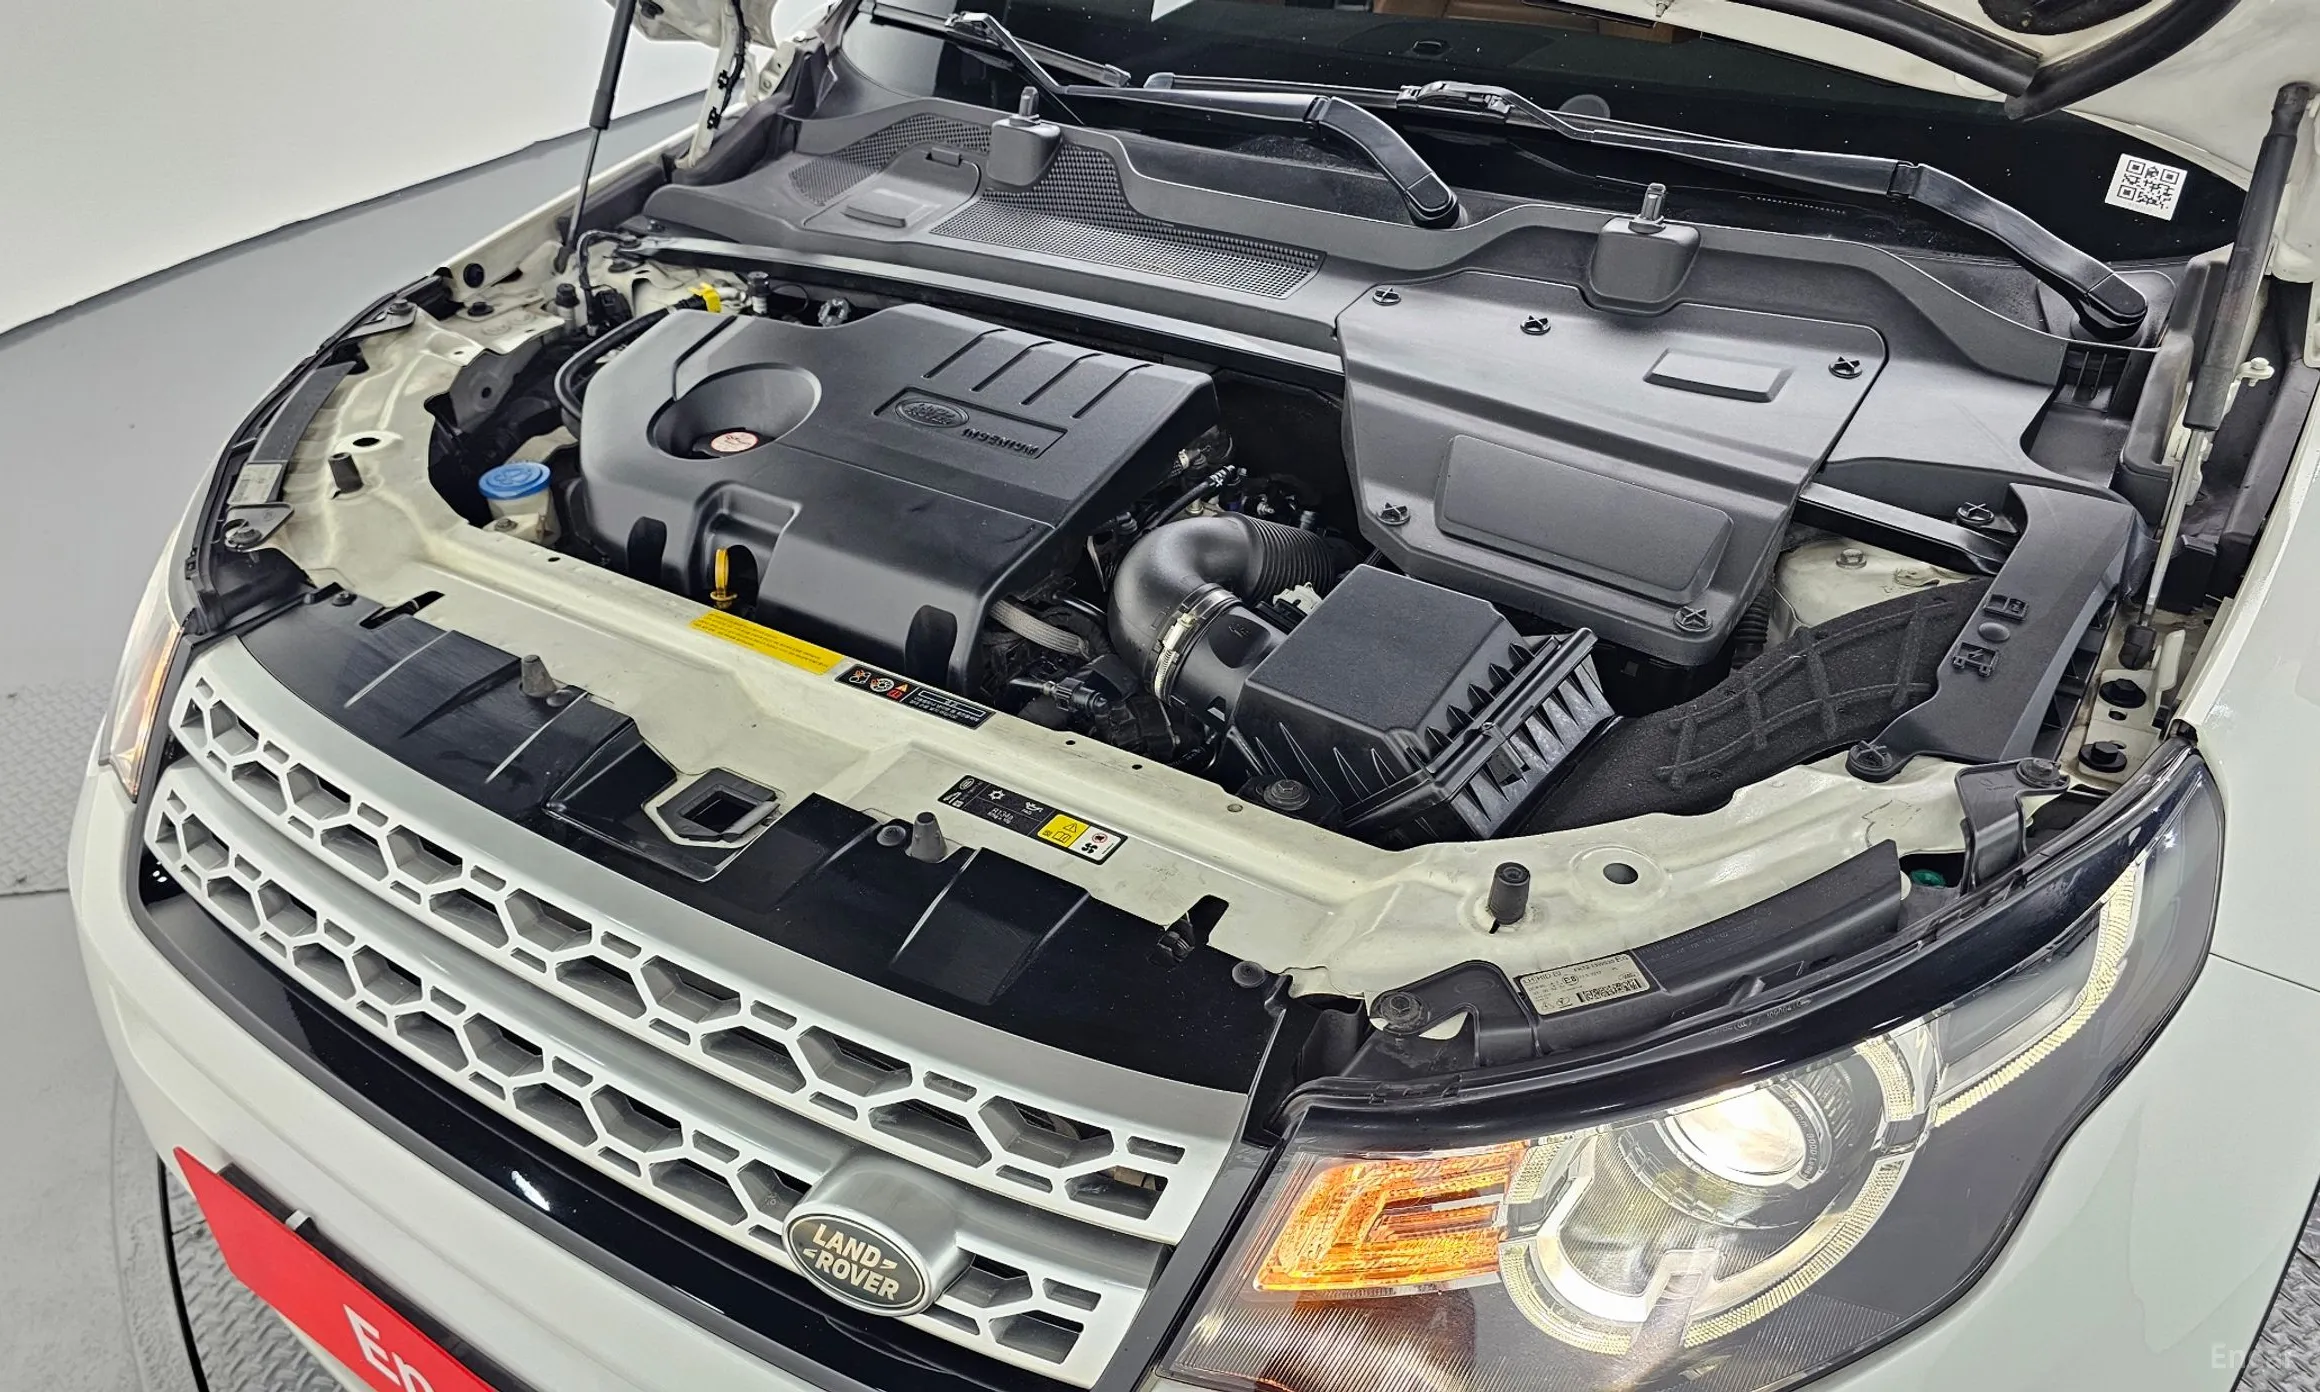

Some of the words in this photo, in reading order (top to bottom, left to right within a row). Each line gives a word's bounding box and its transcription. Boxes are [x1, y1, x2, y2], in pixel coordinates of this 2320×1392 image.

[962, 428, 1039, 455] INGENIUM
[812, 1223, 882, 1268] LAND
[814, 1250, 900, 1301] ROVER
